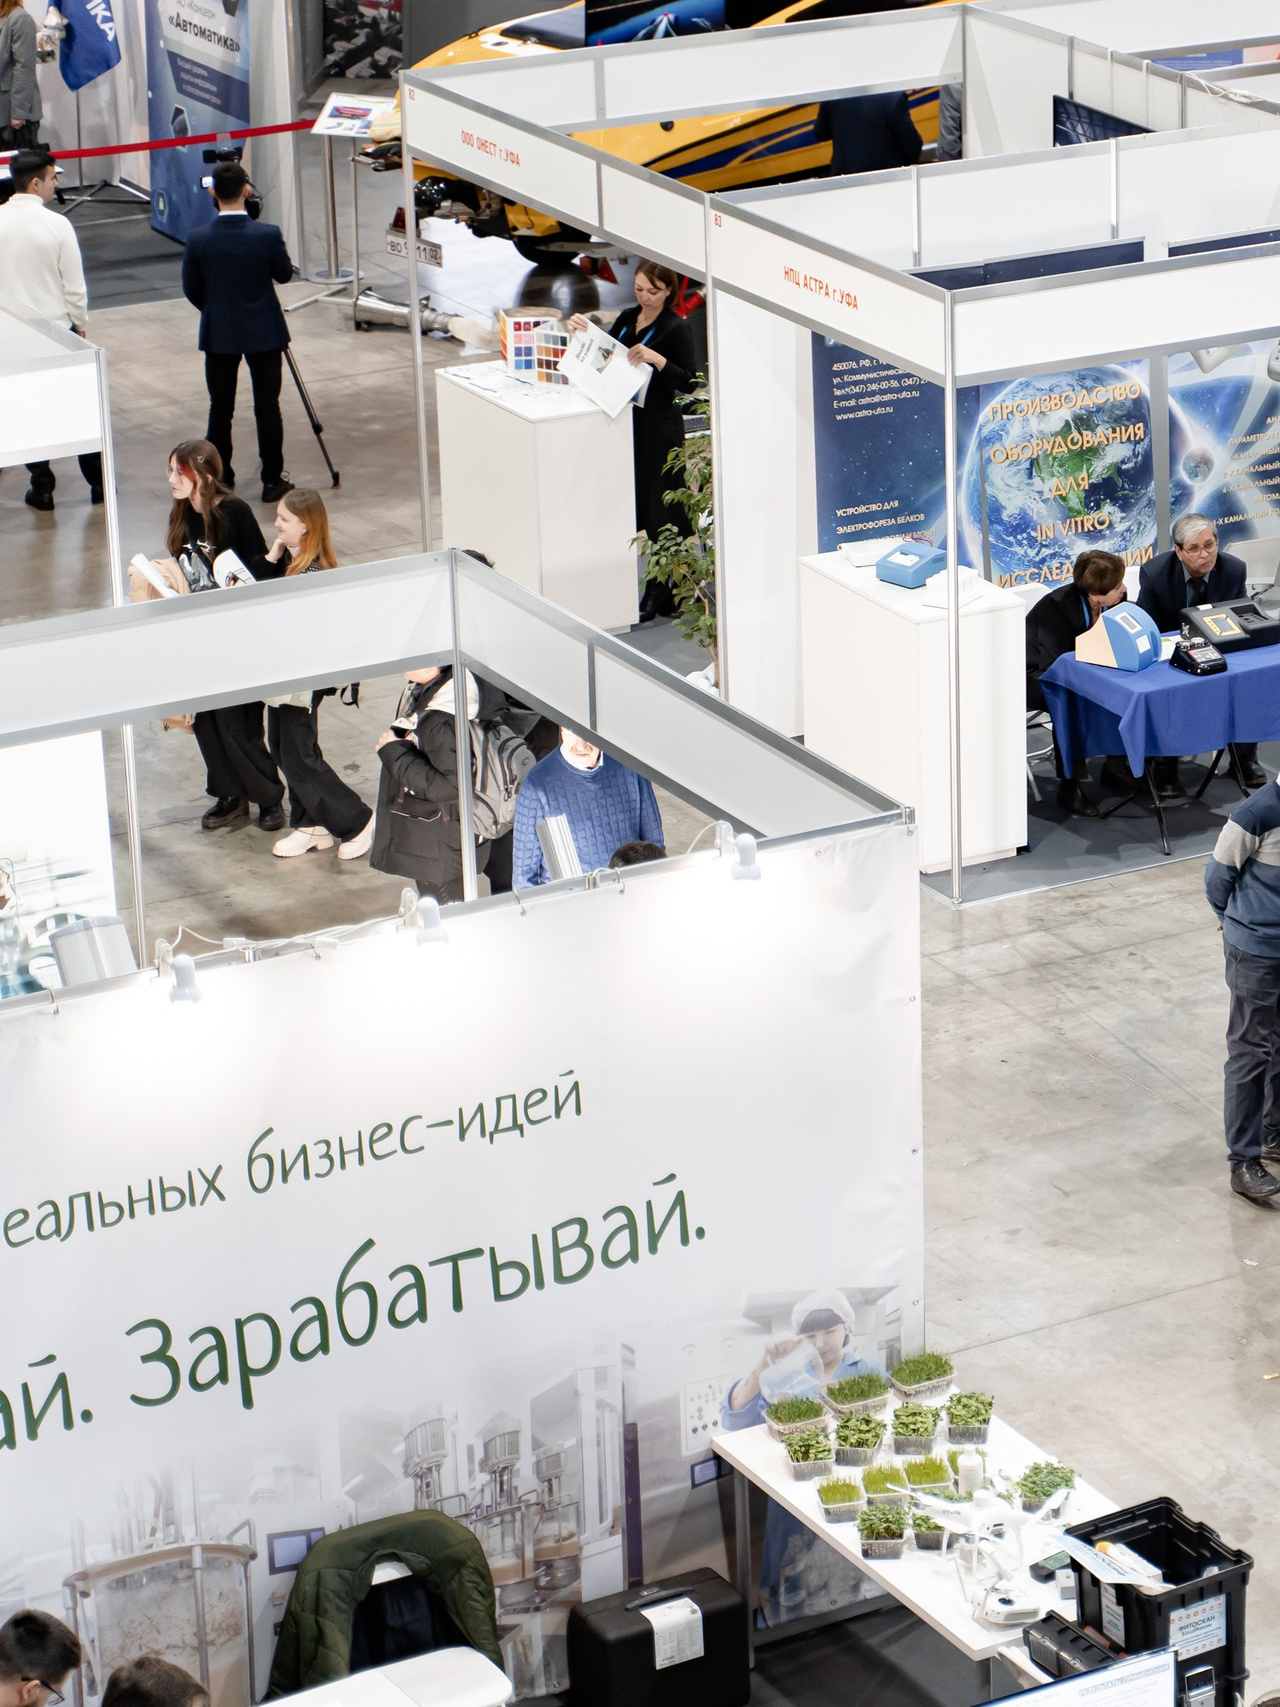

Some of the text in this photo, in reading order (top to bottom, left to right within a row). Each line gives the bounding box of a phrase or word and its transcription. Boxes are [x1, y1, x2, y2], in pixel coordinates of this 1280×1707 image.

[168, 11, 241, 53] «Автоматика»
[461, 130, 475, 147] ООО
[476, 136, 498, 157] ОНЕСТ
[784, 265, 801, 289] НПЦ
[803, 274, 830, 299] АСТРА
[833, 398, 858, 409] E-mail:
[848, 384, 866, 395] (347)
[988, 381, 1142, 422] ПРОИЗВОДСТВО
[989, 422, 1146, 464] ОБОРУДОВАНИЯ
[1229, 432, 1275, 446] ПАРАМЕТРОВ
[1050, 473, 1090, 499] ДЛЯ
[835, 500, 899, 517] УСТРОЙСТВО ДЛЯ
[836, 513, 925, 535] ЭЛЕКТРОФОРЕЗА БЕЛКОВ
[1036, 513, 1111, 542] IN VITRO
[1, 1068, 584, 1250] еальных бизнес-идей
[124, 1172, 708, 1410] Зарабатывай.
